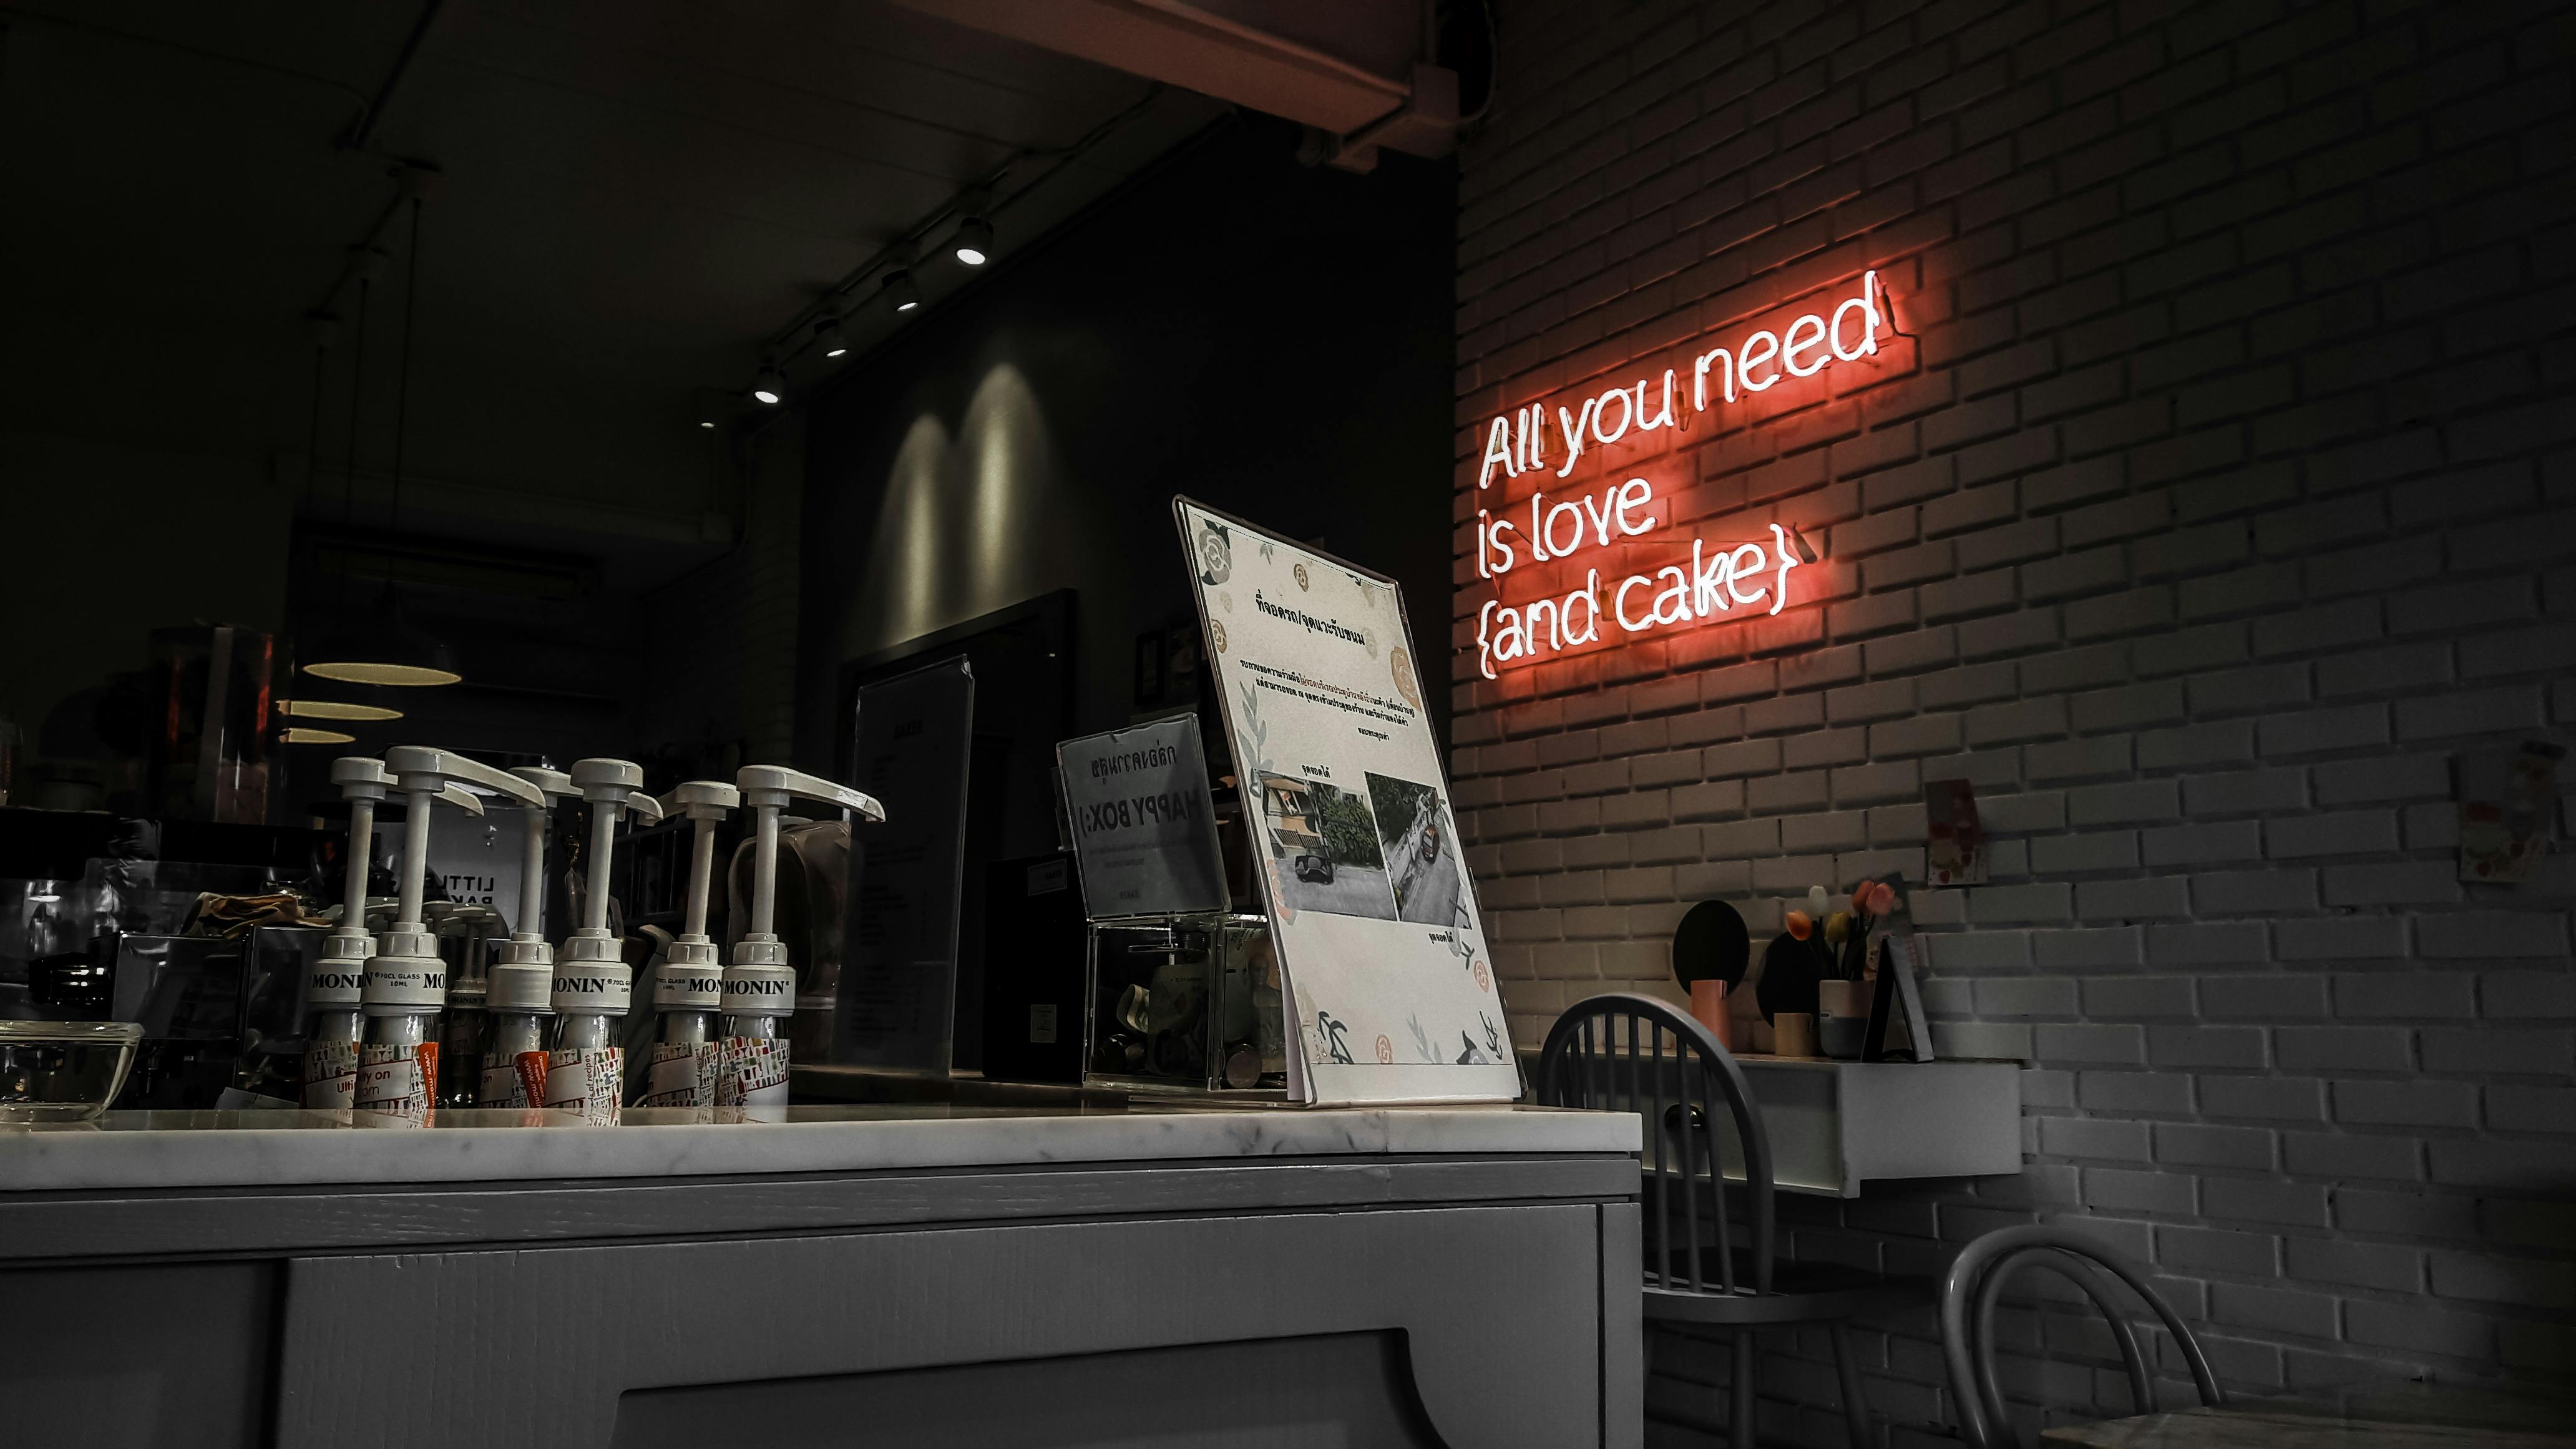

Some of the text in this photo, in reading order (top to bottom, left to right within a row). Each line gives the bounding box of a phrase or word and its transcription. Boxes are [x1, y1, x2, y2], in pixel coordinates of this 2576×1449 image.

[1480, 269, 1879, 489] All you need
[1477, 477, 1656, 578] is love
[313, 973, 362, 988] MONI
[724, 980, 785, 995] MONIN
[375, 1070, 391, 1080] on
[336, 1080, 354, 1093] Ulti
